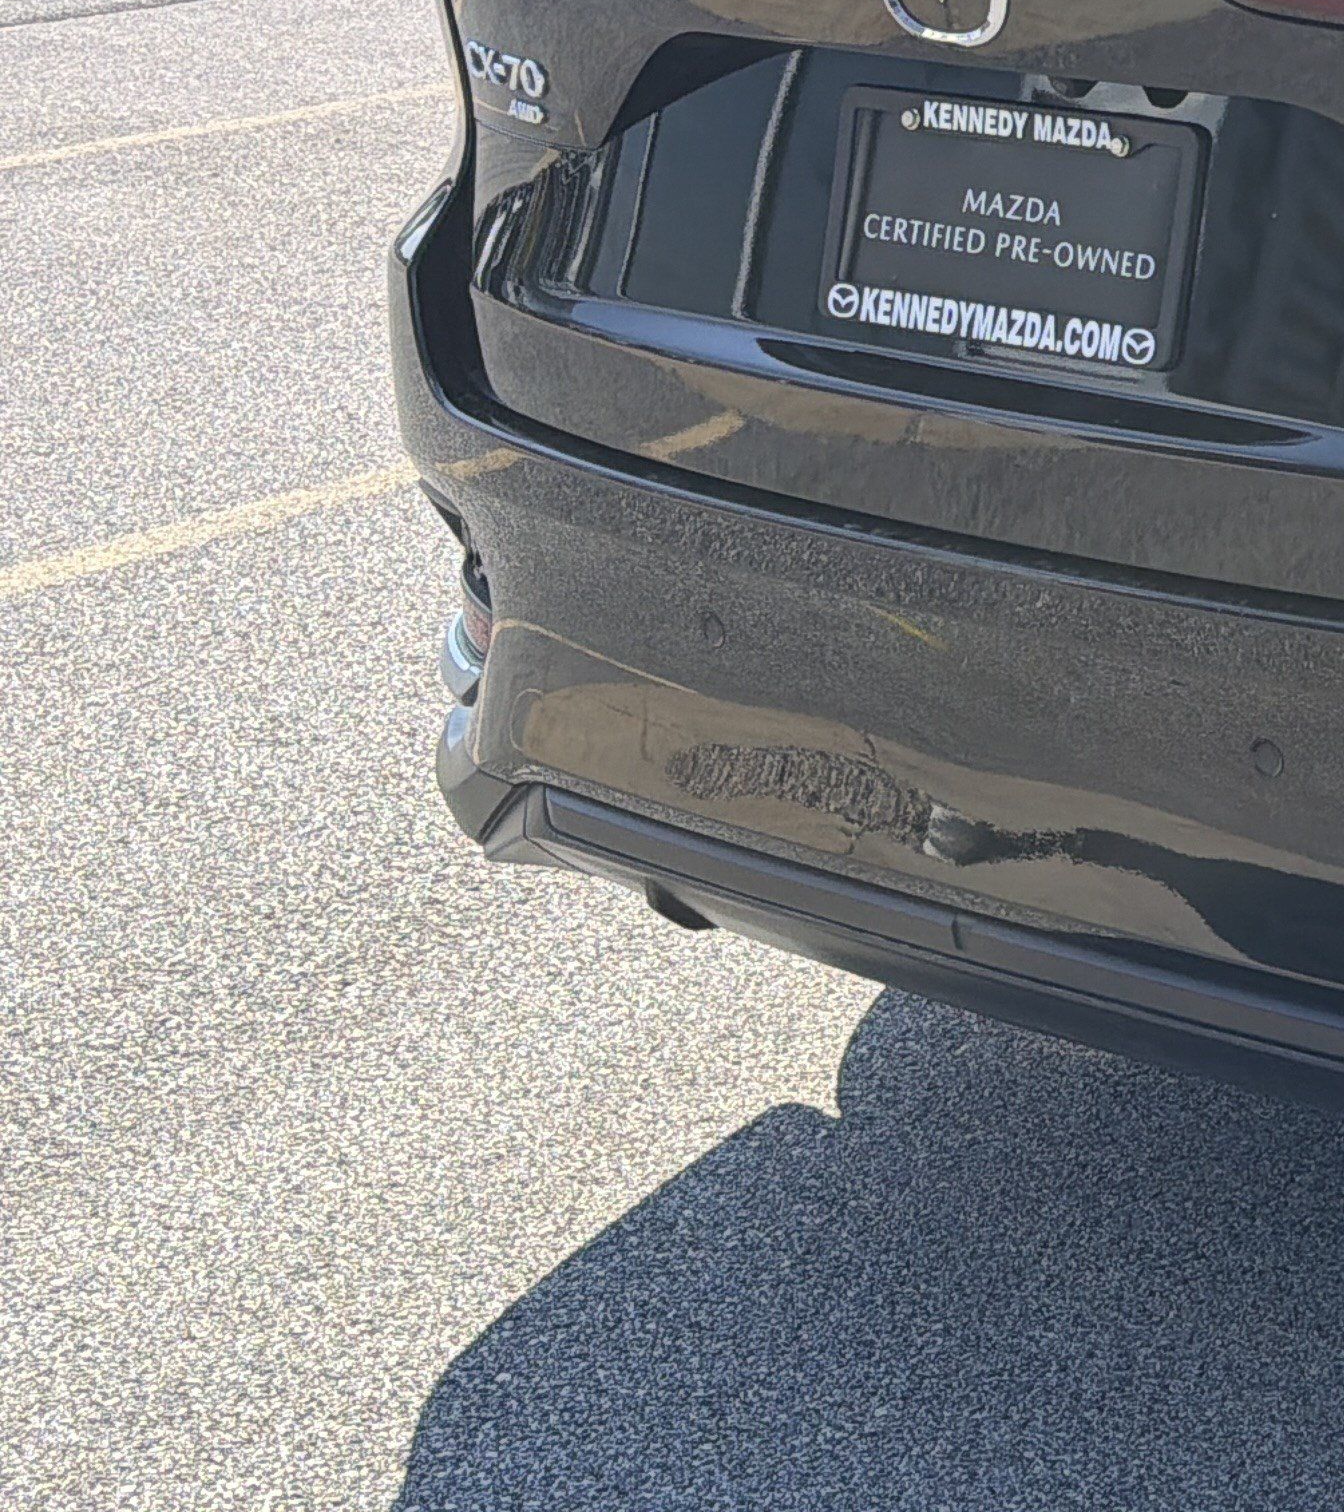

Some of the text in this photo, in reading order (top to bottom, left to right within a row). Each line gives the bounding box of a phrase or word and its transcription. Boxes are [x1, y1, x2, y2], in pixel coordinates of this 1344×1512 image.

[922, 100, 1115, 150] KENNEDY MAZDA
[961, 188, 1061, 226] MAZDA
[863, 213, 1156, 280] CERTIFIED PRE-OWNED
[859, 286, 1122, 362] KENNEDYMAZDA.COM
